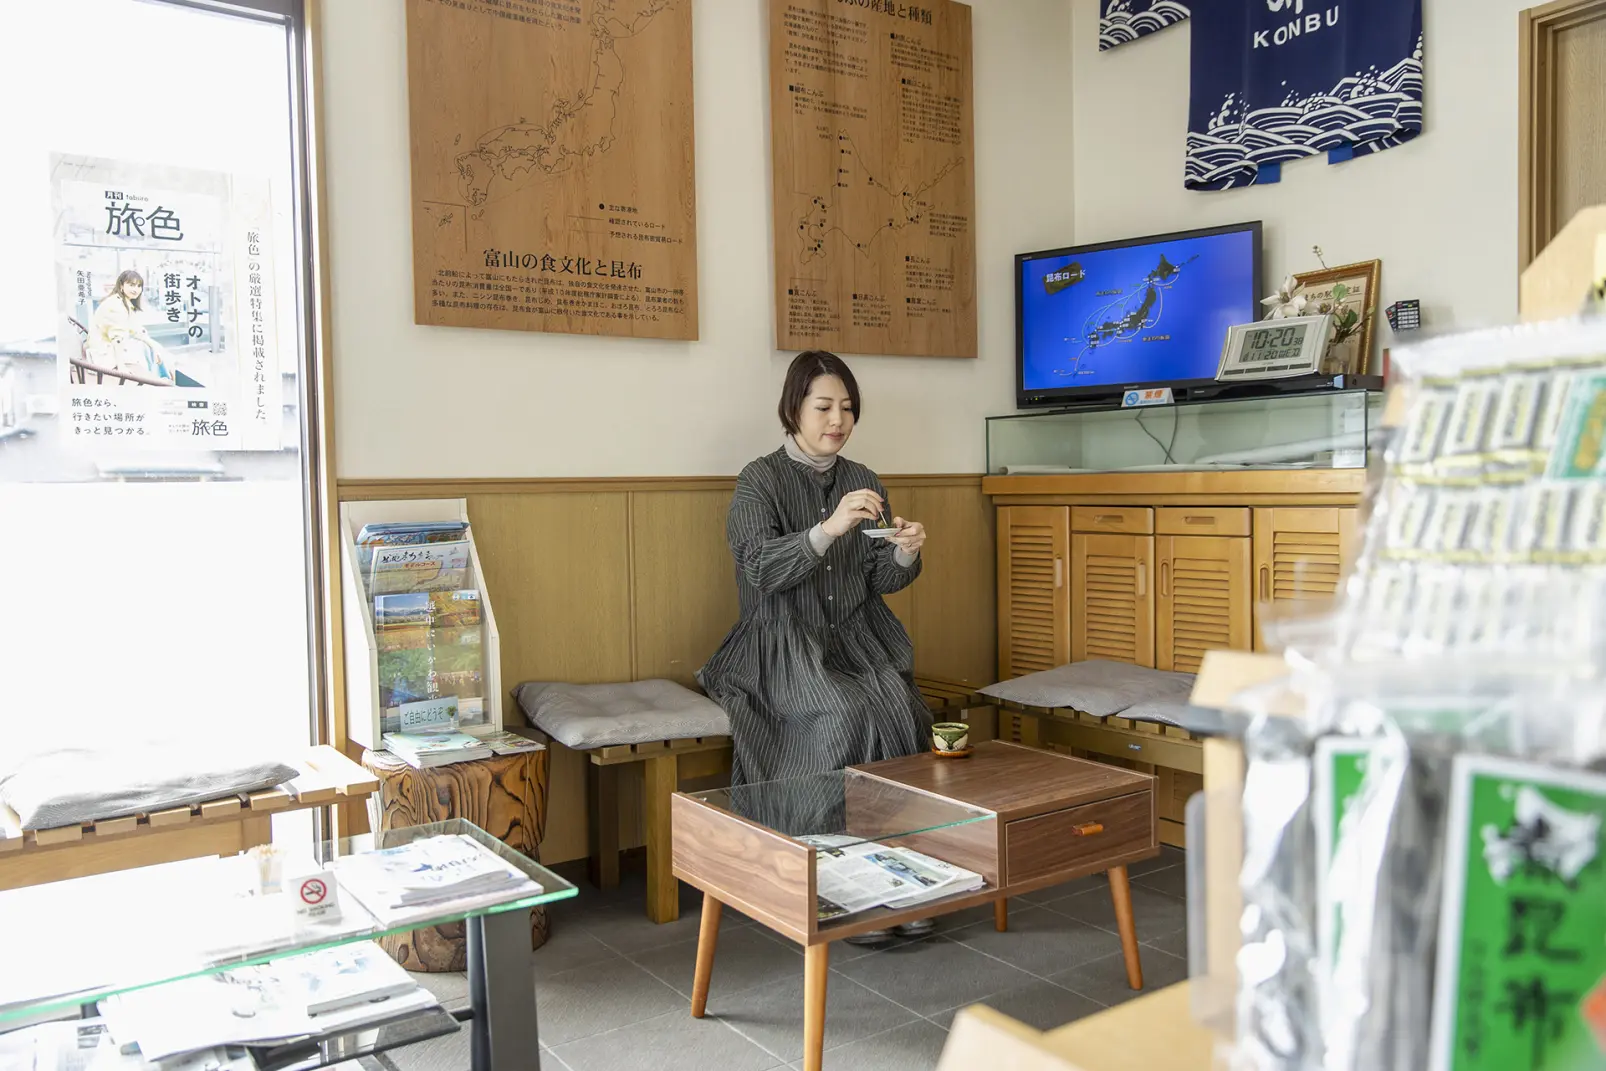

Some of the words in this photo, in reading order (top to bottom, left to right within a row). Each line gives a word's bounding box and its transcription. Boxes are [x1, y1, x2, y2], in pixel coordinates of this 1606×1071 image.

[836, 0, 932, 26] の産地と種類
[1253, 5, 1339, 49] KONBU
[105, 201, 184, 241] 旅色
[484, 248, 642, 280] 富山の食文化と昆布
[1046, 269, 1086, 284] 昆布ロード
[164, 272, 182, 323] 街歩き
[1305, 285, 1361, 302] ちの駅証
[186, 275, 203, 338] オトナの
[1251, 327, 1296, 350] 10:20
[1264, 350, 1277, 360] 20
[72, 398, 117, 407] 旅色なら、
[73, 412, 145, 422] 行きたい場所が
[191, 419, 229, 437] 旅色
[404, 706, 444, 726] ご自由にどうぞ
